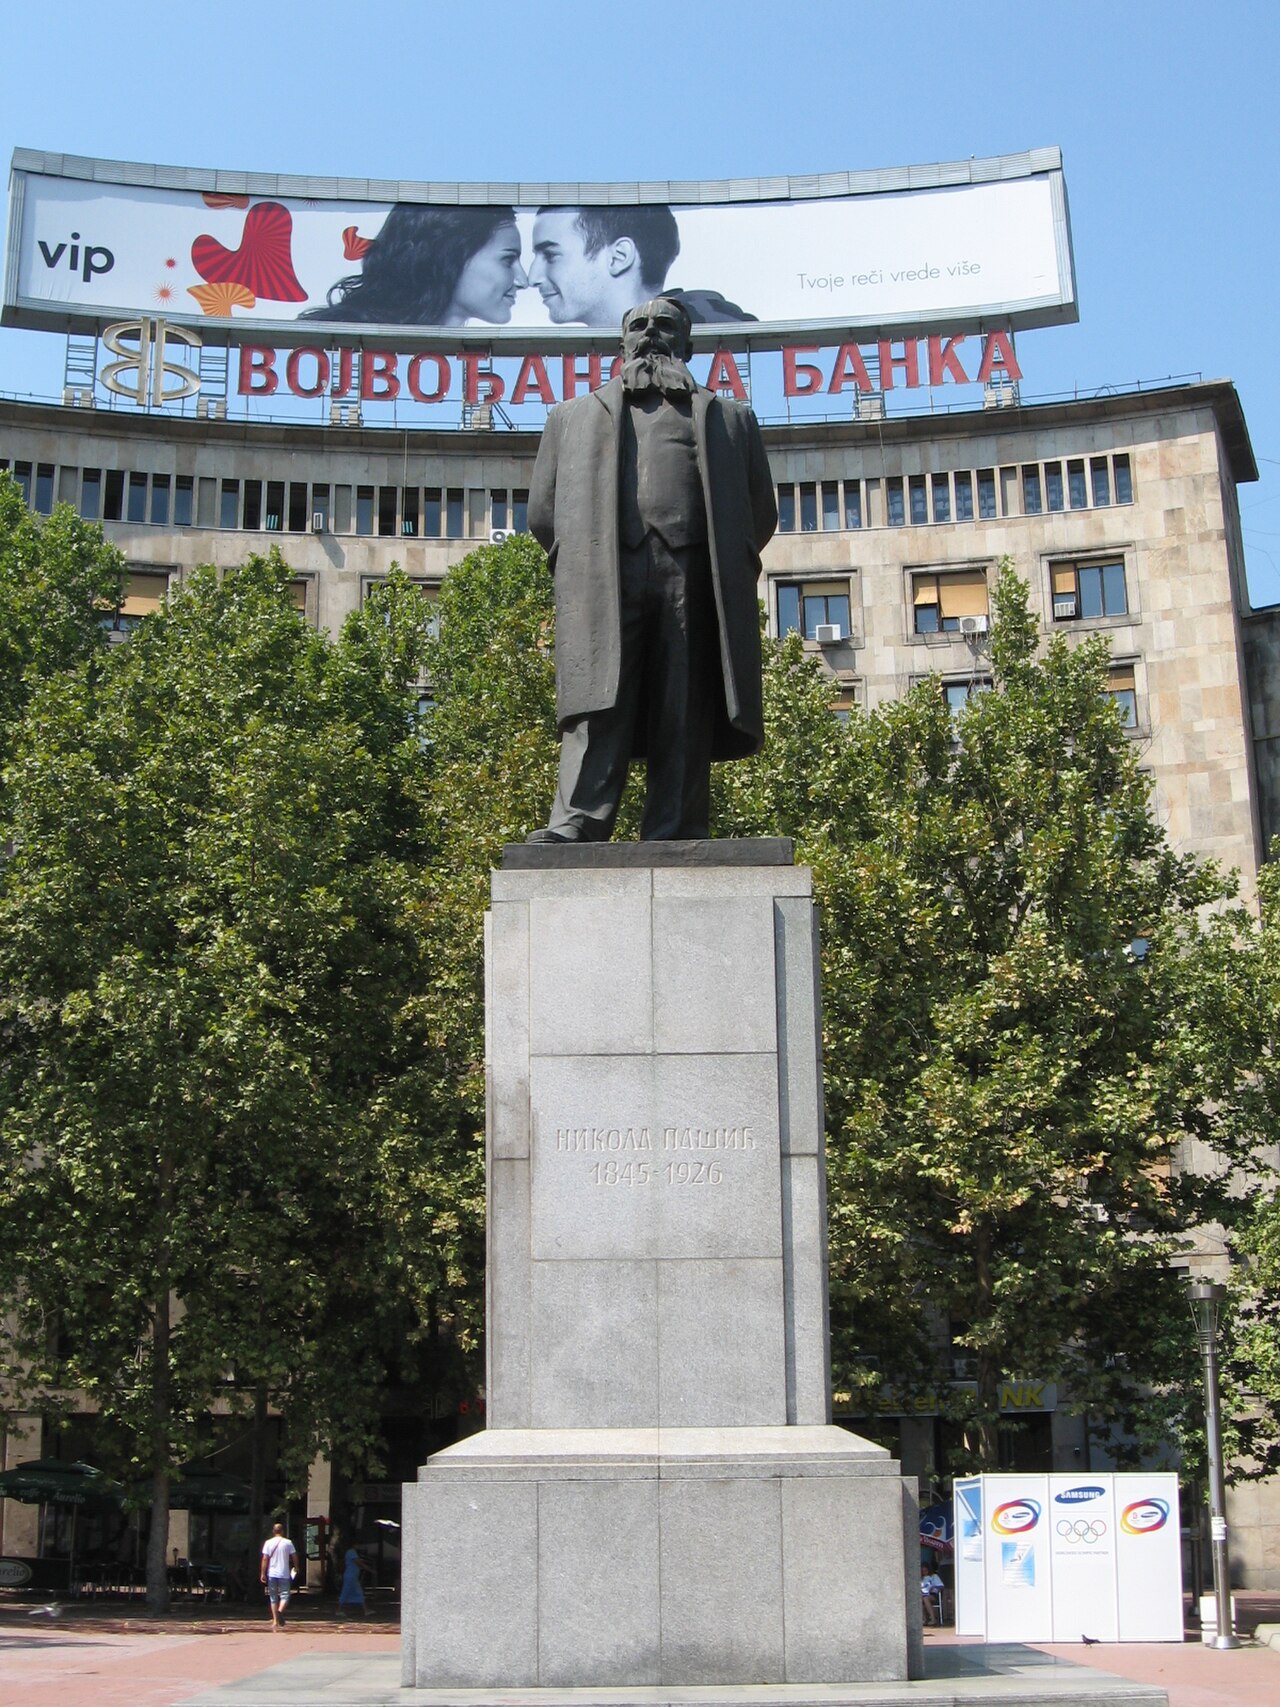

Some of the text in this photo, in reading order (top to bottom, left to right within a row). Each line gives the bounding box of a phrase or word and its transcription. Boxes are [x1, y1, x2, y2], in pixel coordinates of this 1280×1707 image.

[37, 232, 115, 283] vip
[797, 260, 981, 292] Tvoje reči vrede više
[237, 329, 1023, 405] ВОЈВОЂАНА БАНКА
[556, 1127, 756, 1151] НИКОЛА ПАШИЋ
[589, 1160, 723, 1187] 1845-1926
[1060, 1491, 1101, 1499] SAMSUNG
